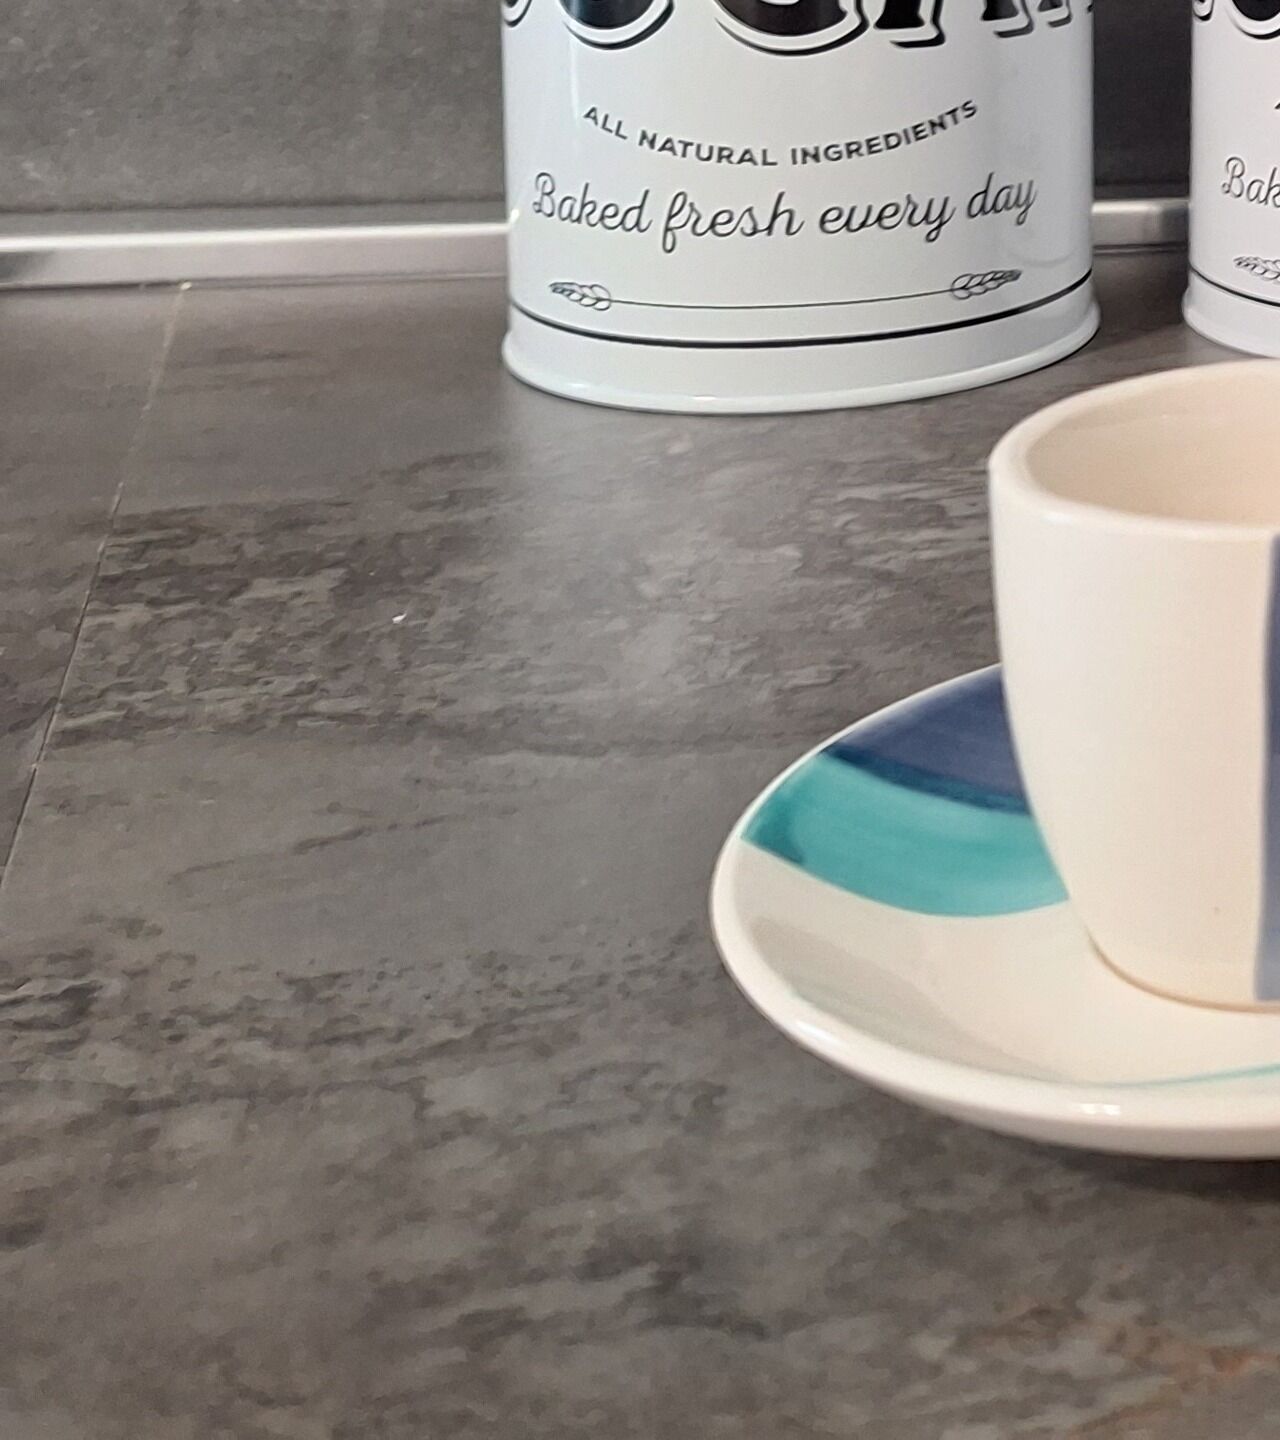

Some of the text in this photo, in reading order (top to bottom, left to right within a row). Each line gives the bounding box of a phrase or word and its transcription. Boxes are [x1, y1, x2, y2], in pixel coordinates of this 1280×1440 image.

[583, 100, 978, 166] ALL NATURAL INGREDIENTS
[532, 171, 1037, 253] Baked fresh every day
